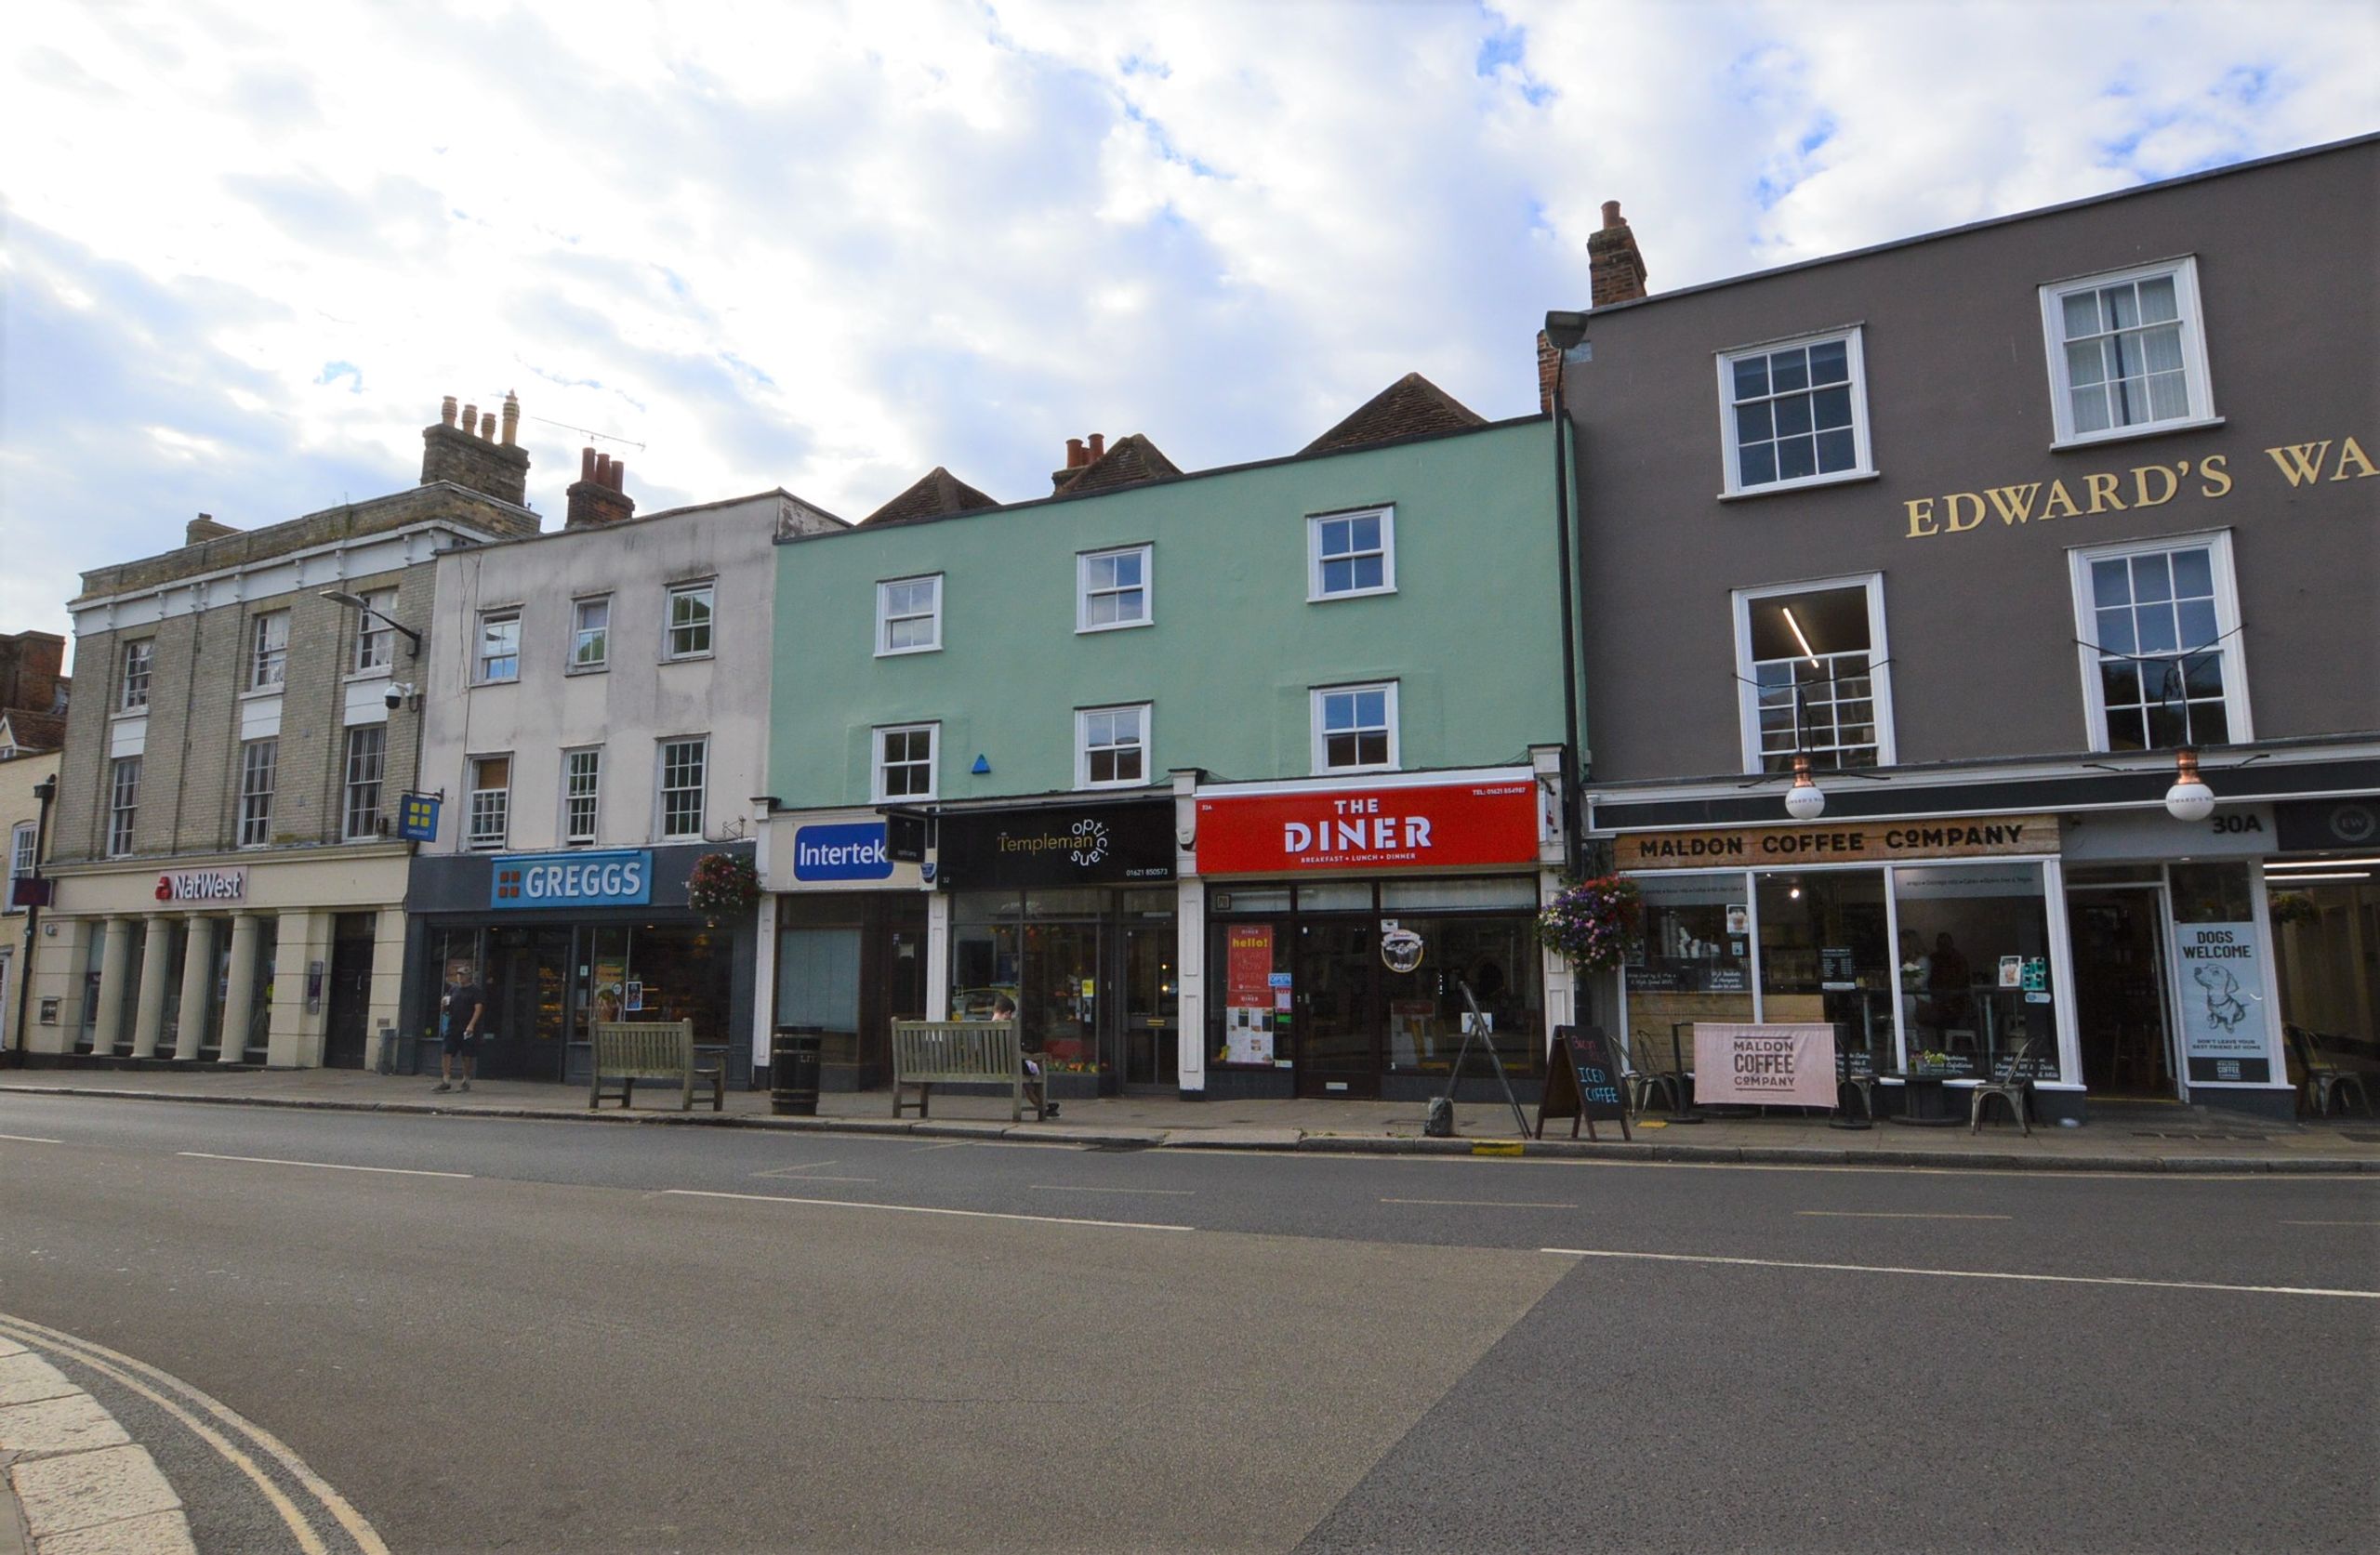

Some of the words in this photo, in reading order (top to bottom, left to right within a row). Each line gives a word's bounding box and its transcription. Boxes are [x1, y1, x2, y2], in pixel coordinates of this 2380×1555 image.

[1902, 455, 2233, 539] EDWARD'S
[1334, 798, 1379, 815] THE
[1284, 815, 1433, 853] DINER
[2212, 814, 2264, 834] 30A
[800, 838, 889, 866] Intertek
[998, 833, 1093, 855] Templeman
[1071, 818, 1109, 867] opticians
[1640, 837, 1743, 857] MALDON
[1762, 832, 1864, 853] COFFEE
[1301, 855, 1343, 863] BREAKFAST
[525, 862, 641, 899] GREGGS
[1145, 867, 1169, 876] 850573
[173, 872, 242, 900] NatWest
[1232, 938, 1268, 948] hello!
[2197, 930, 2234, 944] DOGS
[2183, 945, 2252, 958] WELCOME
[1733, 1041, 1793, 1051] MALDON
[1734, 1054, 1795, 1074] COFFEE
[1578, 1067, 1606, 1083] ICED
[1585, 1087, 1619, 1103] COFFEE
